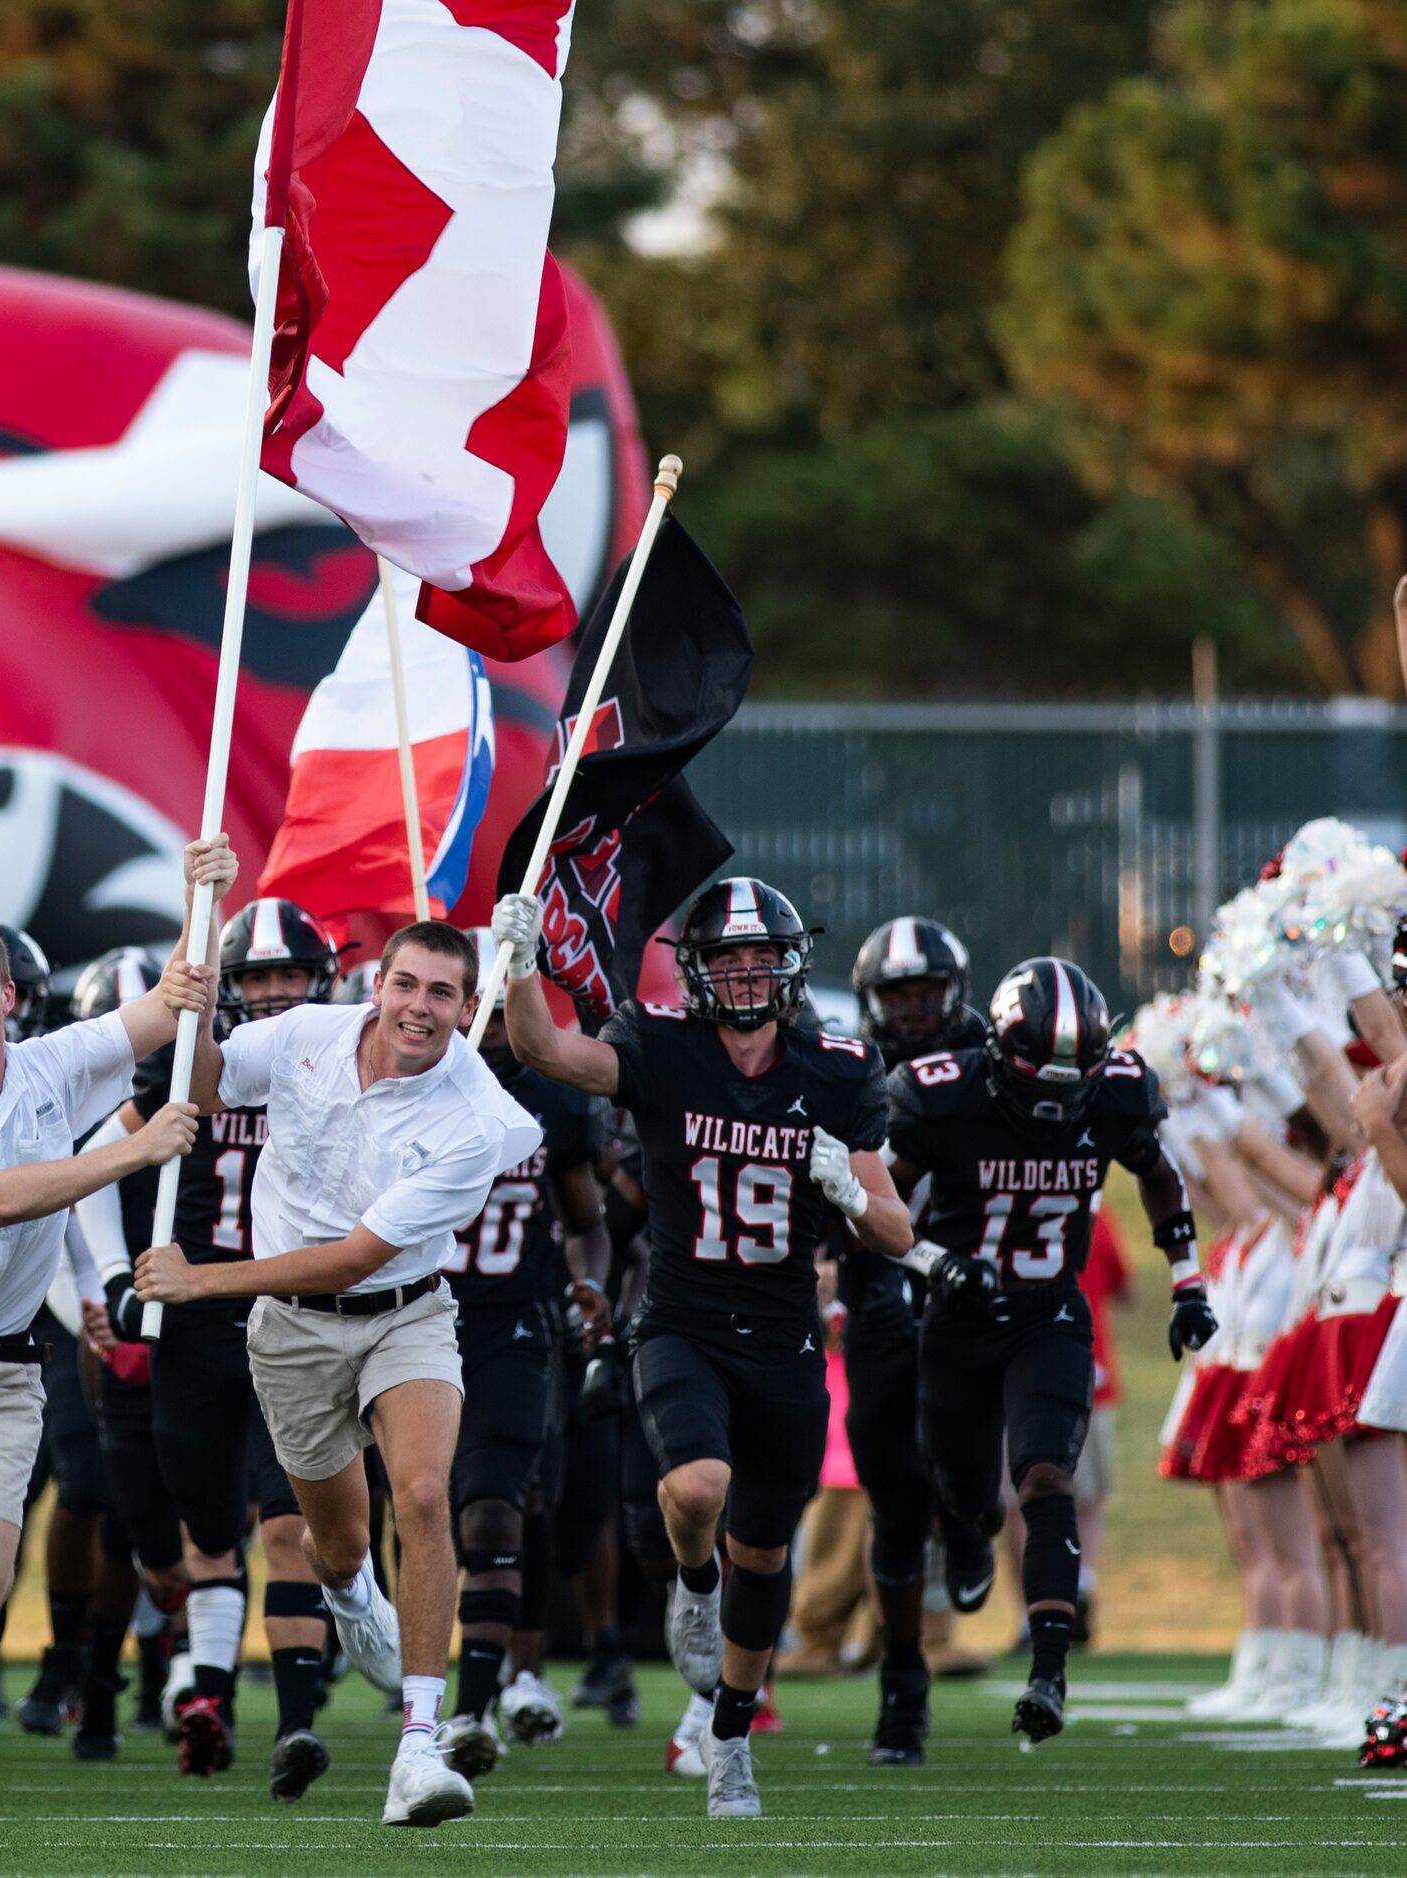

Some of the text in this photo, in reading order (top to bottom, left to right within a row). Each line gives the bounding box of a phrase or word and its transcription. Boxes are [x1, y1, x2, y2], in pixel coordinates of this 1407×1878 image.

[301, 1057, 314, 1072] Ben
[909, 1051, 961, 1086] 13
[684, 1111, 810, 1161] WILDCATS
[978, 1159, 1099, 1193] WILDCATS
[690, 1156, 794, 1267] 19
[979, 1193, 1080, 1280] 13
